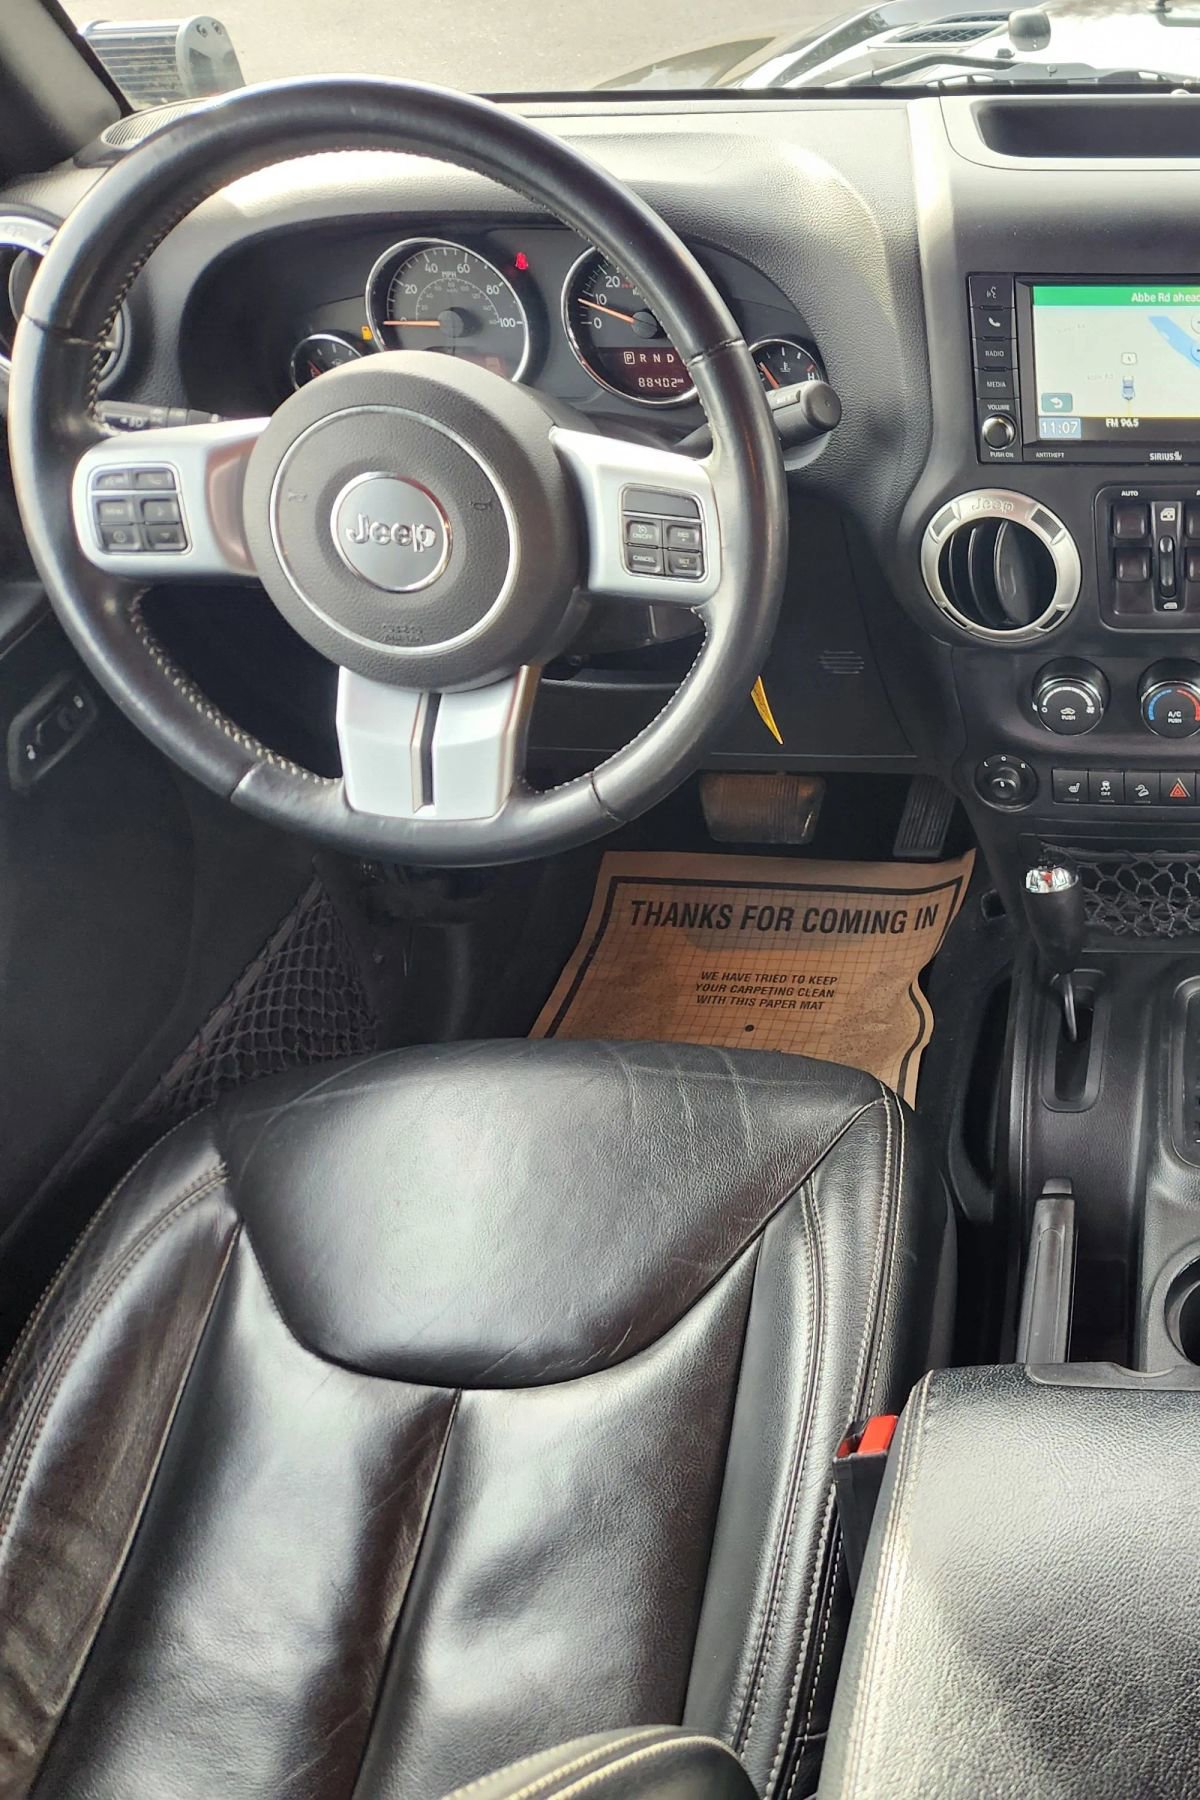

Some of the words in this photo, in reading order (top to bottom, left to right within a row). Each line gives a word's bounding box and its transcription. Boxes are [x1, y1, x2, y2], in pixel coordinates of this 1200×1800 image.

[425, 264, 438, 273] 40
[457, 264, 470, 273] 60
[605, 275, 620, 288] 20
[405, 284, 417, 294] 20
[486, 285, 499, 294] 80
[595, 294, 607, 305] 10
[1131, 292, 1156, 303] Abbe
[1158, 292, 1171, 302] Rd
[500, 318, 515, 327] 100
[593, 321, 602, 329] 0
[640, 354, 647, 362] R
[653, 354, 661, 362] N
[667, 354, 675, 362] D
[1041, 421, 1078, 434] 11:07
[1105, 418, 1119, 428] FM
[1120, 418, 1140, 428] 96.5
[1150, 452, 1175, 461] SIRIUS
[972, 498, 1014, 513] Jeep
[346, 513, 436, 552] Jeep
[631, 901, 733, 930] THANKS
[740, 905, 793, 932] FOR
[802, 908, 907, 934] COMING
[914, 904, 939, 931] IN
[701, 971, 720, 981] WE
[721, 972, 753, 982] HAVE
[755, 973, 788, 984] TRIED
[791, 974, 806, 985] TO
[808, 976, 838, 986] KEEP
[695, 983, 728, 993] YOUR
[730, 984, 795, 996] CARPETING
[797, 987, 835, 998] CLEAN
[696, 994, 727, 1005] WITH
[729, 996, 756, 1006] THIS
[758, 998, 797, 1009] PAPER
[799, 1001, 826, 1010] MAT
